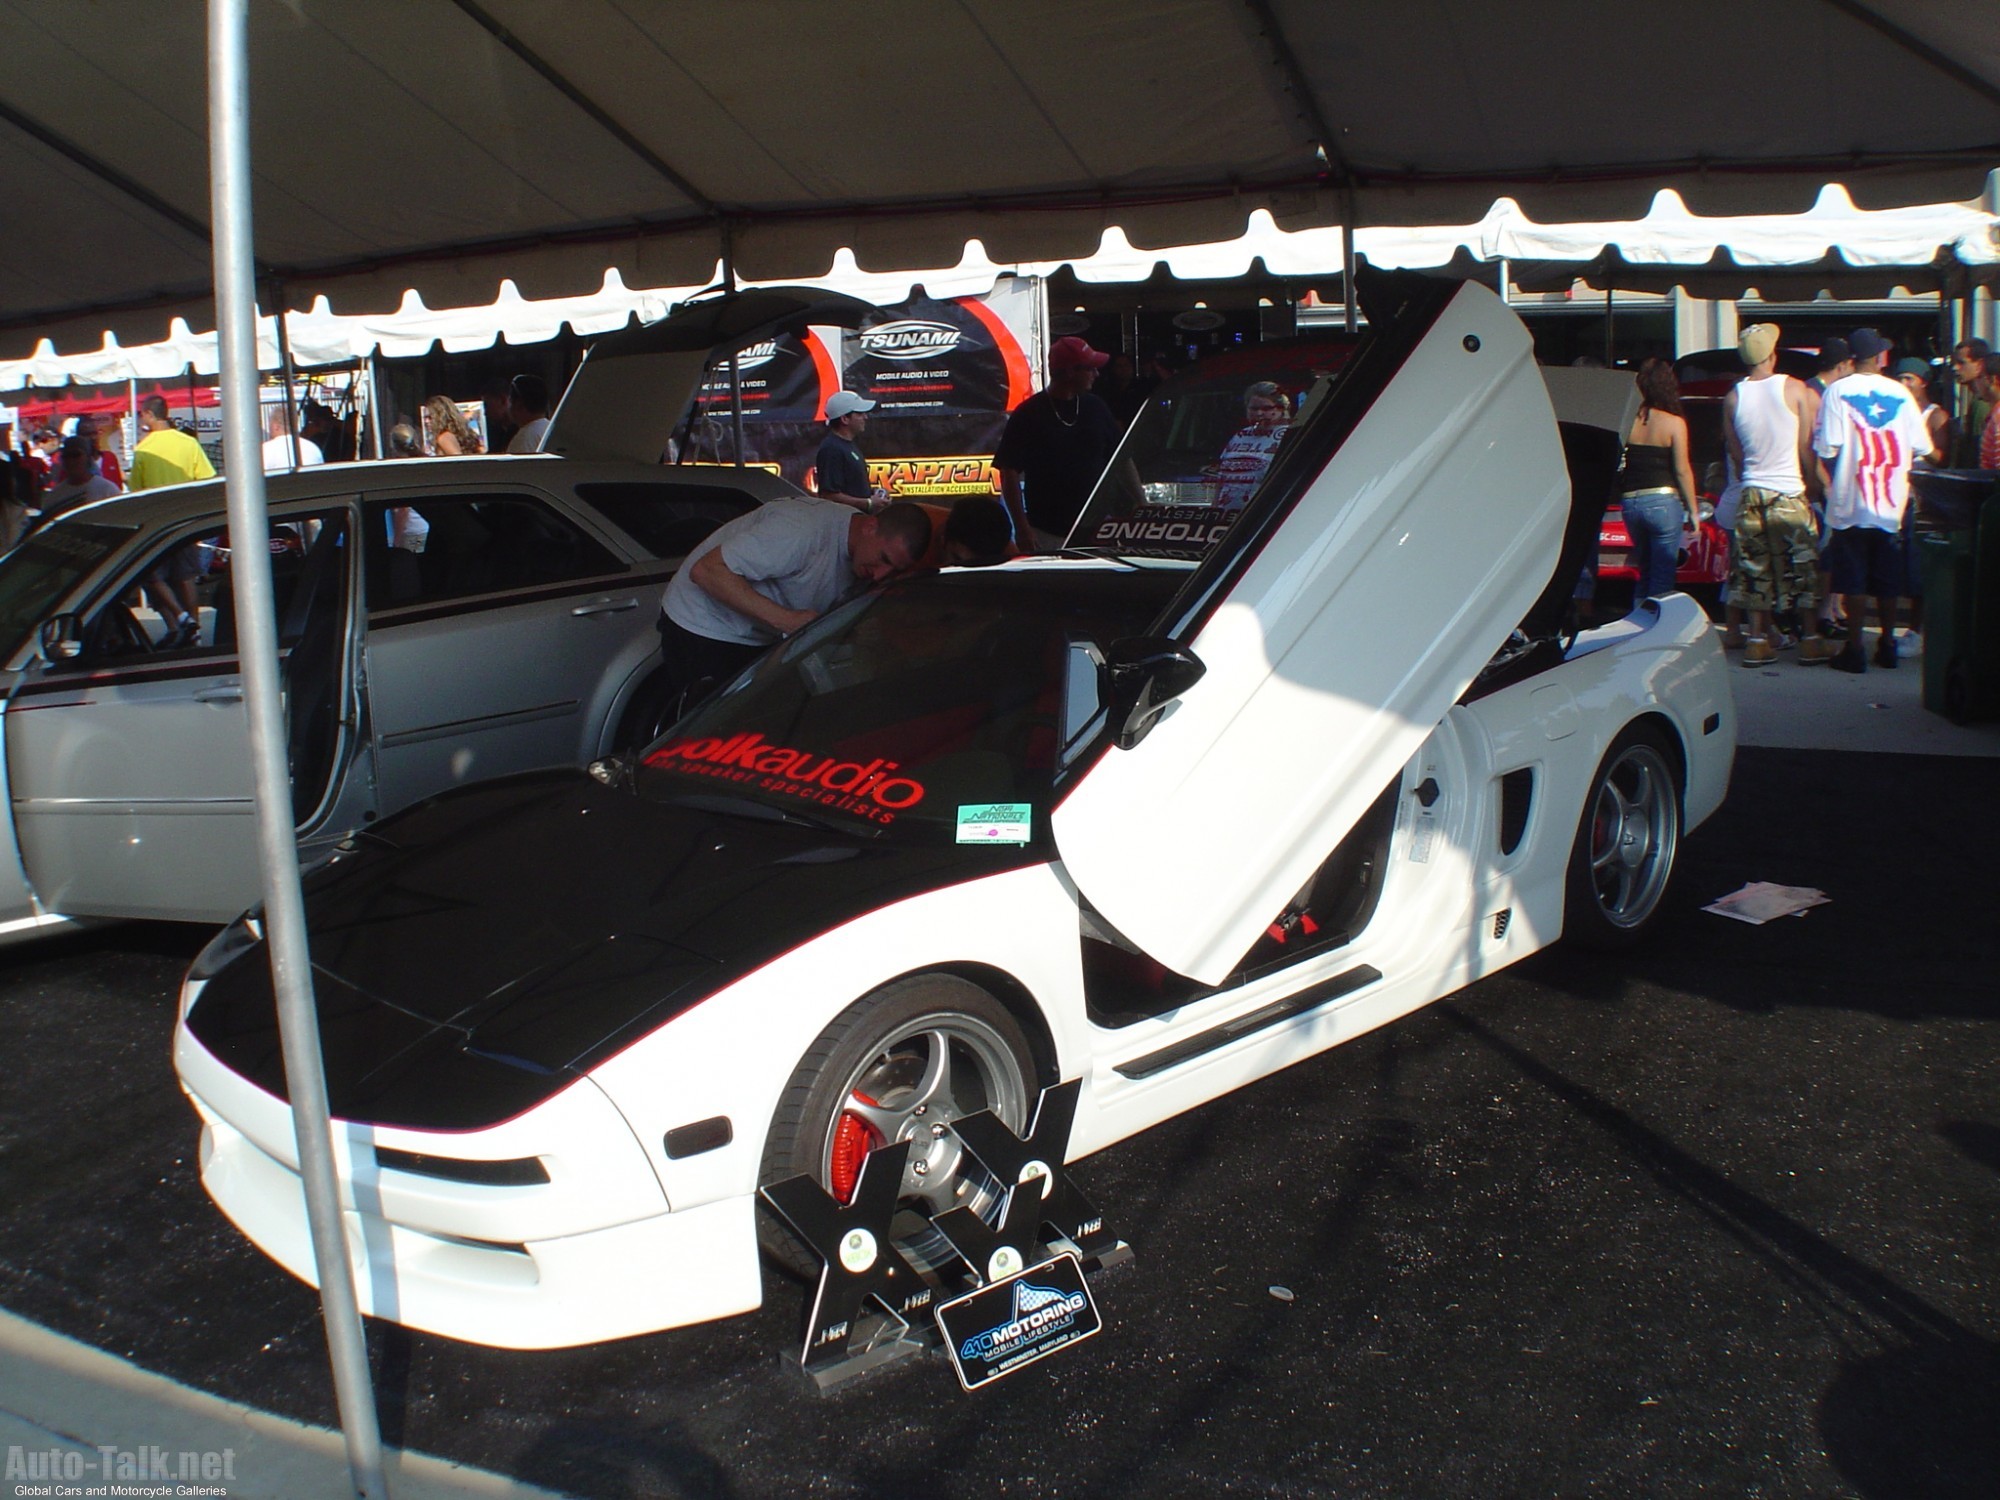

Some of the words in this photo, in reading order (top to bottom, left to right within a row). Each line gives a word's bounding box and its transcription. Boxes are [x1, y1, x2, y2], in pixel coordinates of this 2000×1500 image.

[859, 331, 961, 349] TSUNAMI
[746, 379, 767, 388] VIDEO
[875, 372, 900, 380] MOBILE
[901, 371, 923, 379] AUDIO
[929, 370, 949, 378] VIDEO
[904, 485, 945, 494] INSTALLATION
[946, 484, 989, 493] ACCESSORIES
[1133, 509, 1220, 520] LIFESTYLE
[642, 731, 925, 809] polkaudio
[680, 761, 753, 783] speaker
[761, 777, 896, 824] specialists
[984, 1338, 1020, 1358] MOBILE
[1024, 1316, 1071, 1341] LIFESTYLE
[1039, 1334, 1069, 1352] MARYLAND
